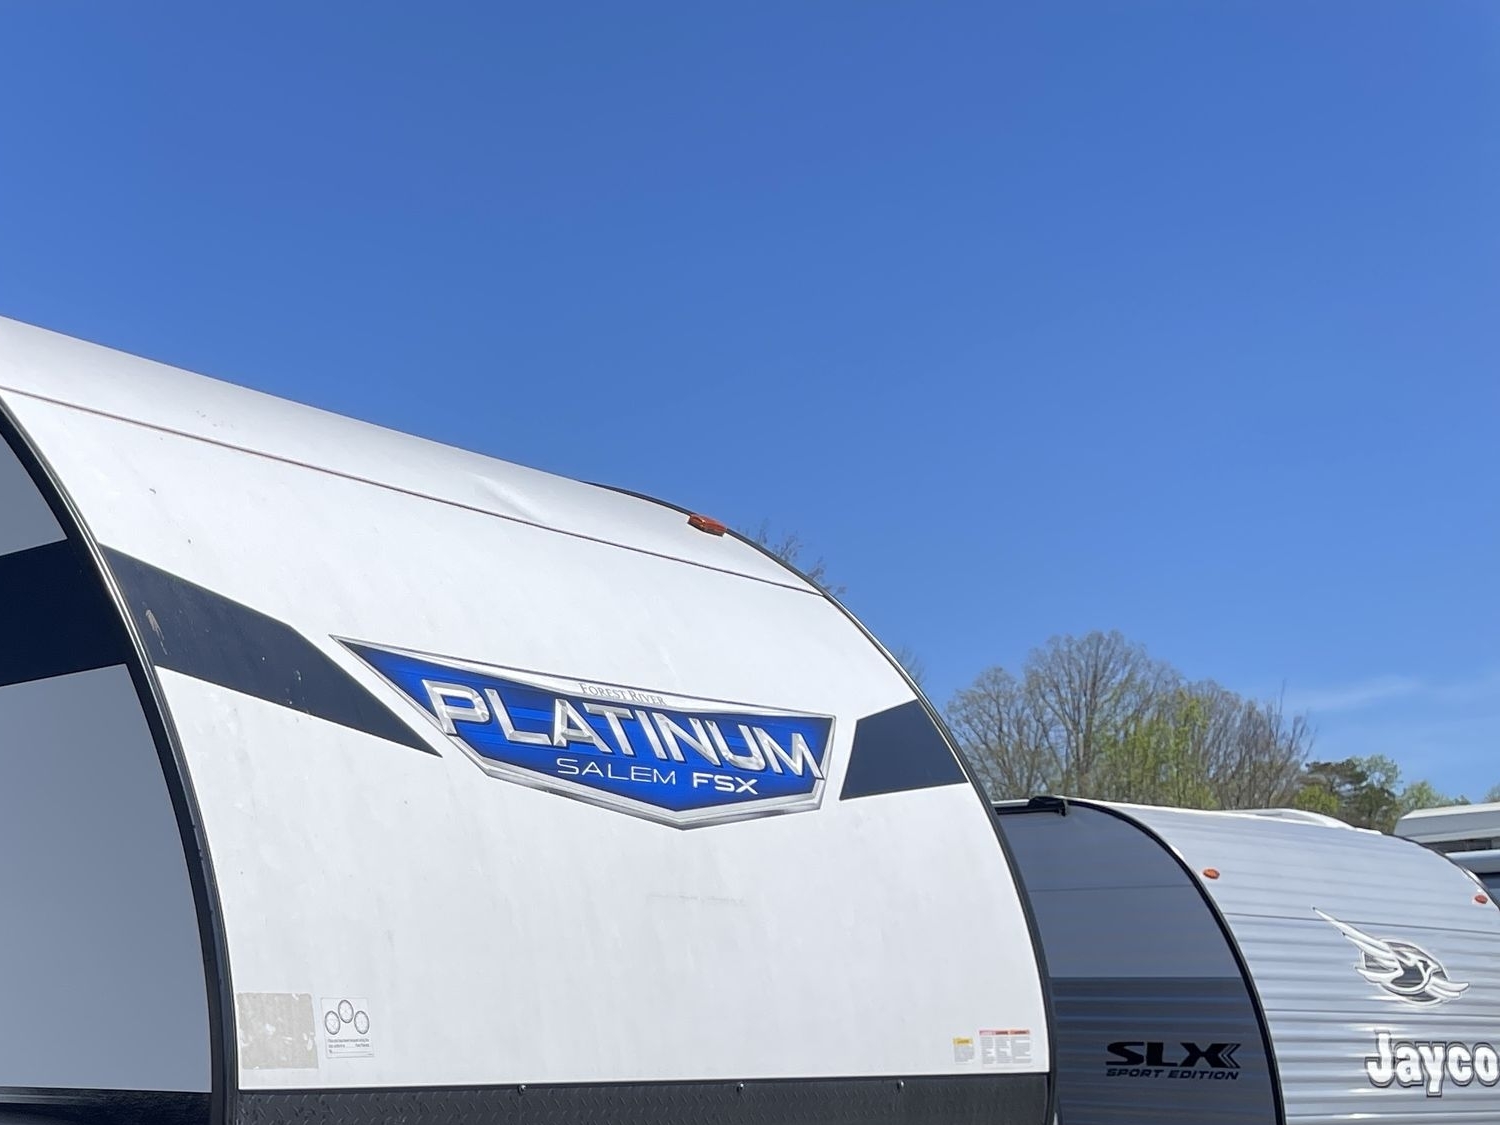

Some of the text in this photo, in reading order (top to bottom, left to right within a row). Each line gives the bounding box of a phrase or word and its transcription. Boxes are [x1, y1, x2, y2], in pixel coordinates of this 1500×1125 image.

[422, 679, 824, 780] PLATINUM
[556, 757, 759, 796] SALEM FSX
[1105, 1041, 1241, 1069] SLX
[1105, 1067, 1240, 1081] SPORT EDITION
[1364, 1029, 1500, 1098] Jayco
